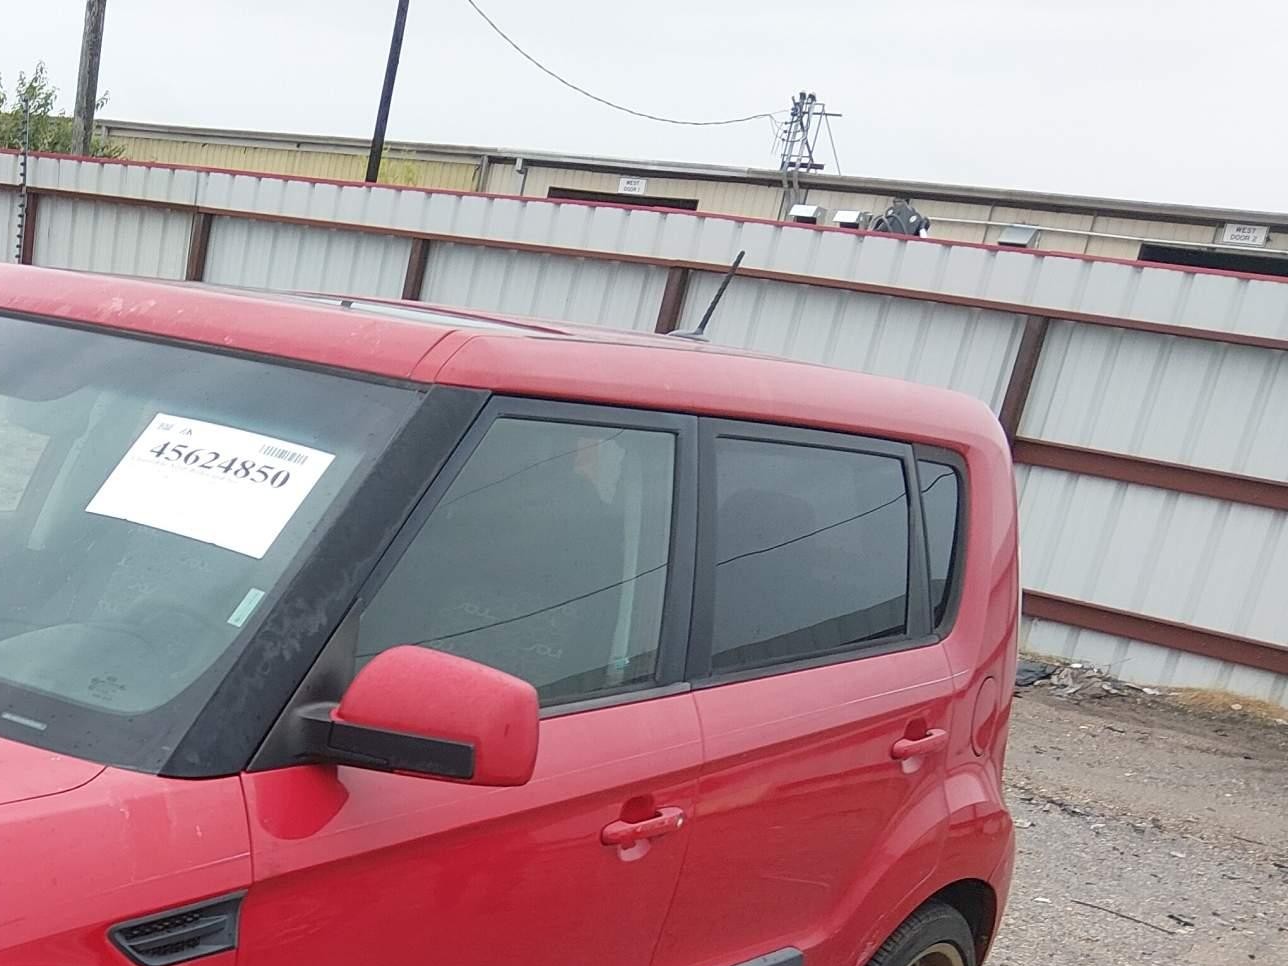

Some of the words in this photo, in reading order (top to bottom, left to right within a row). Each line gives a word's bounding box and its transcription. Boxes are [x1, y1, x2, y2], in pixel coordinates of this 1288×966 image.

[1235, 226, 1257, 234] WEST
[1230, 233, 1250, 241] DOOR
[149, 441, 291, 488] 45624850
